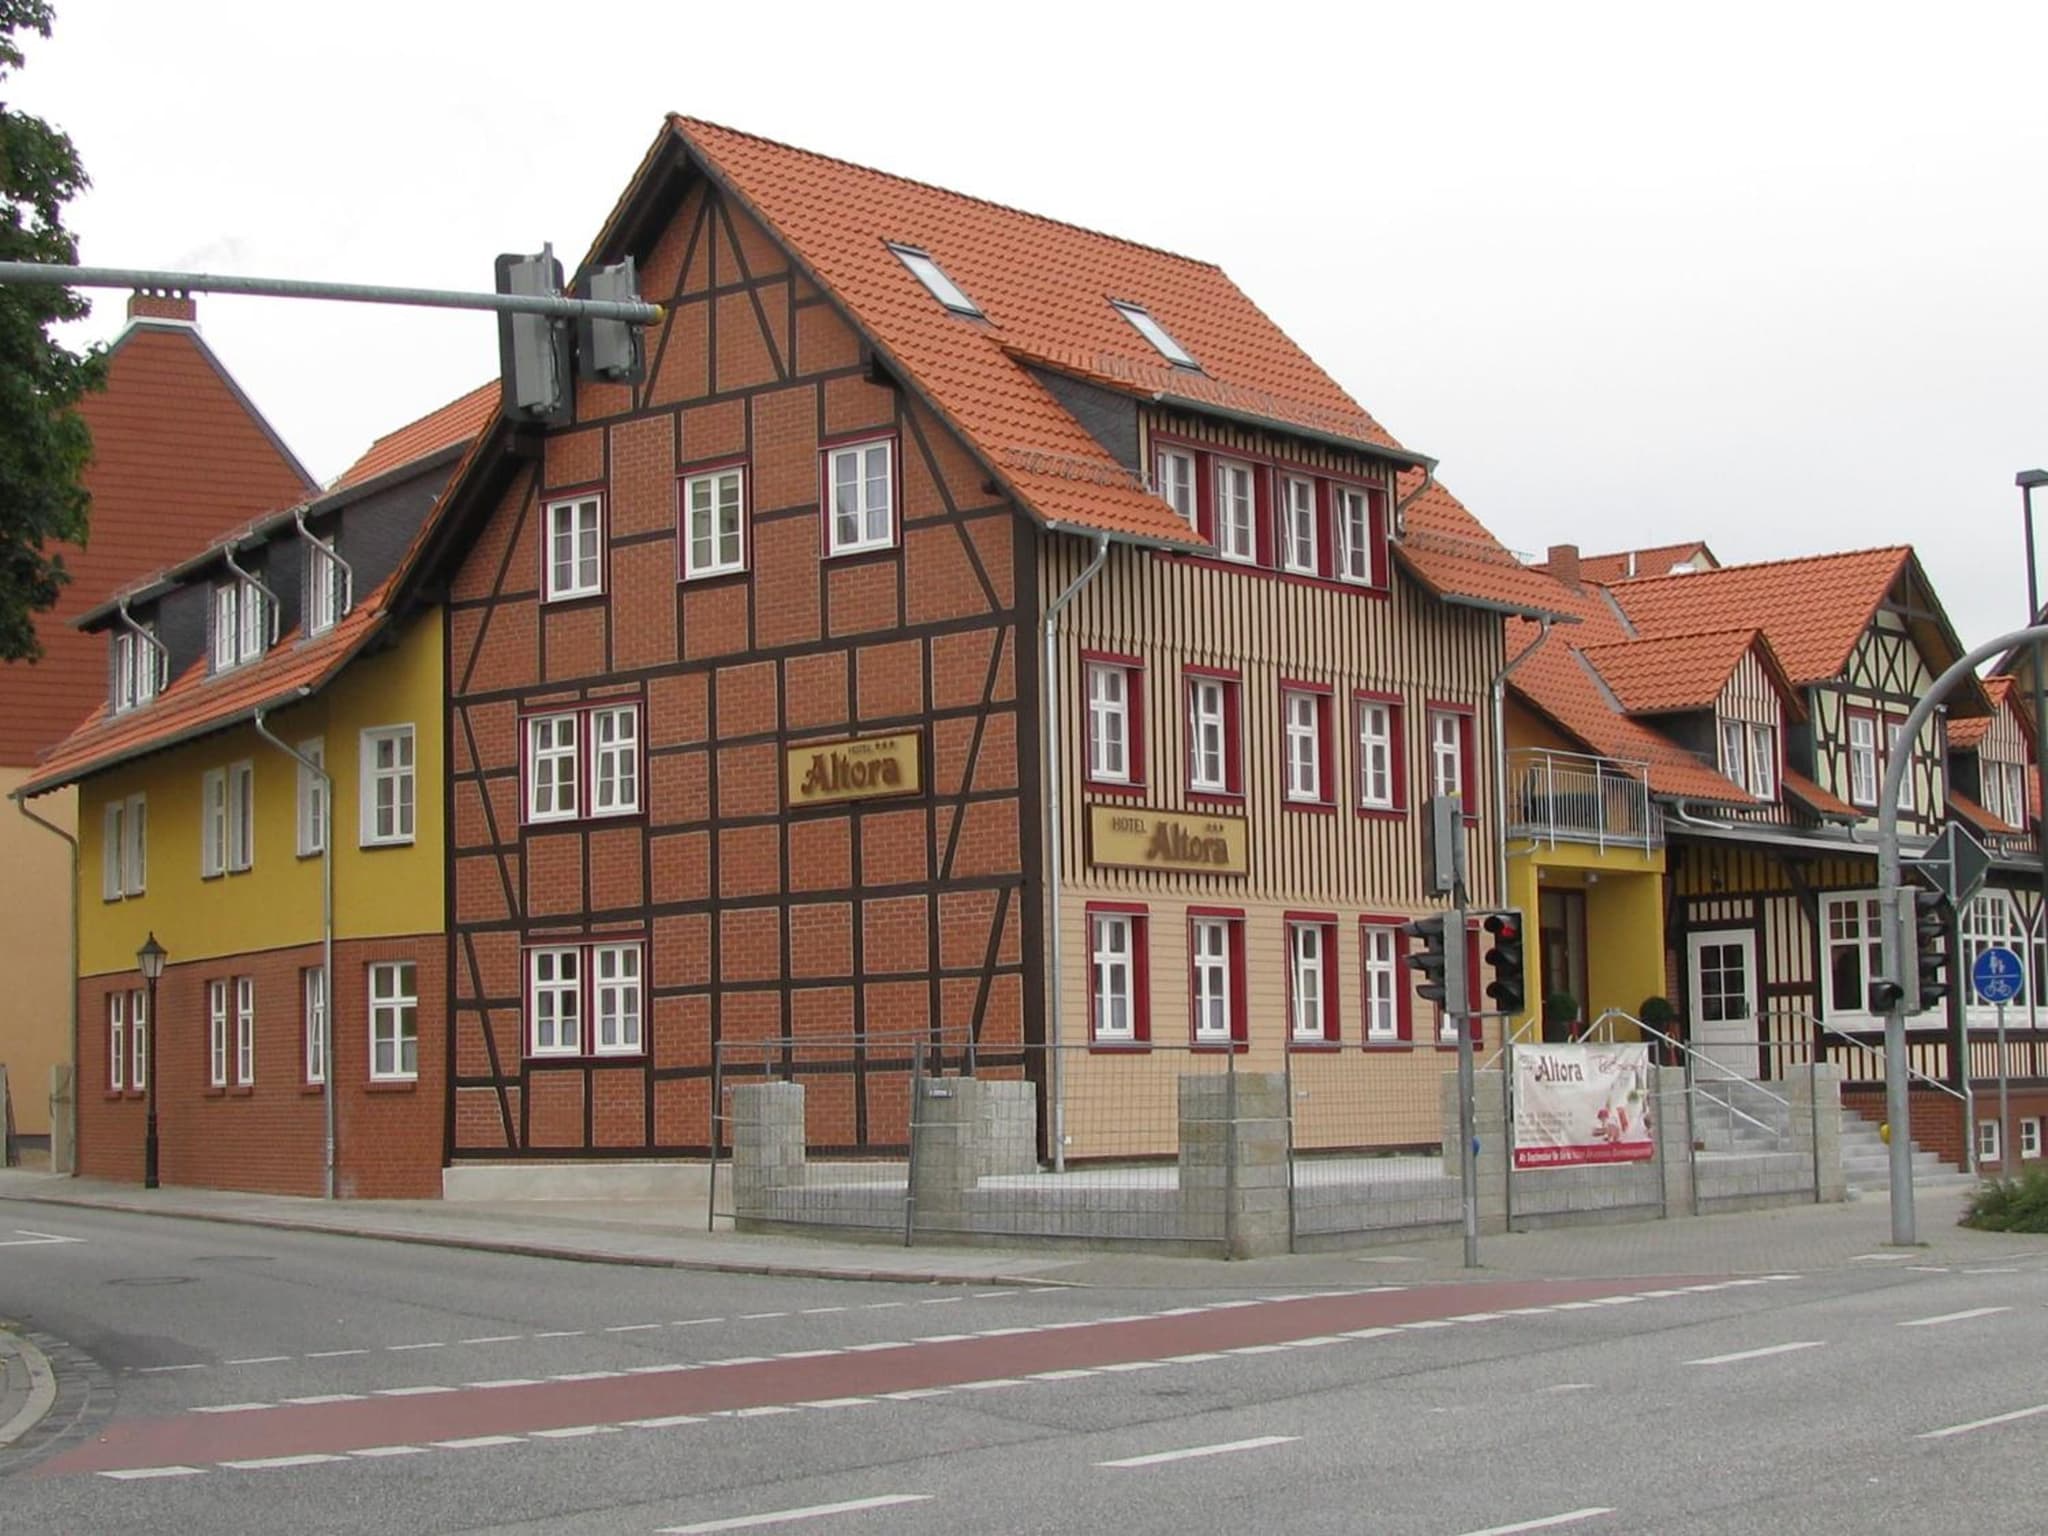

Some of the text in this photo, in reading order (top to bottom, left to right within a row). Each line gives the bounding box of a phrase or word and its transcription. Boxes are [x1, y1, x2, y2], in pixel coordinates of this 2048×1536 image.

[801, 750, 900, 796] Altora
[1112, 816, 1230, 865] HOTEL Altora
[1534, 1054, 1584, 1082] Altora
